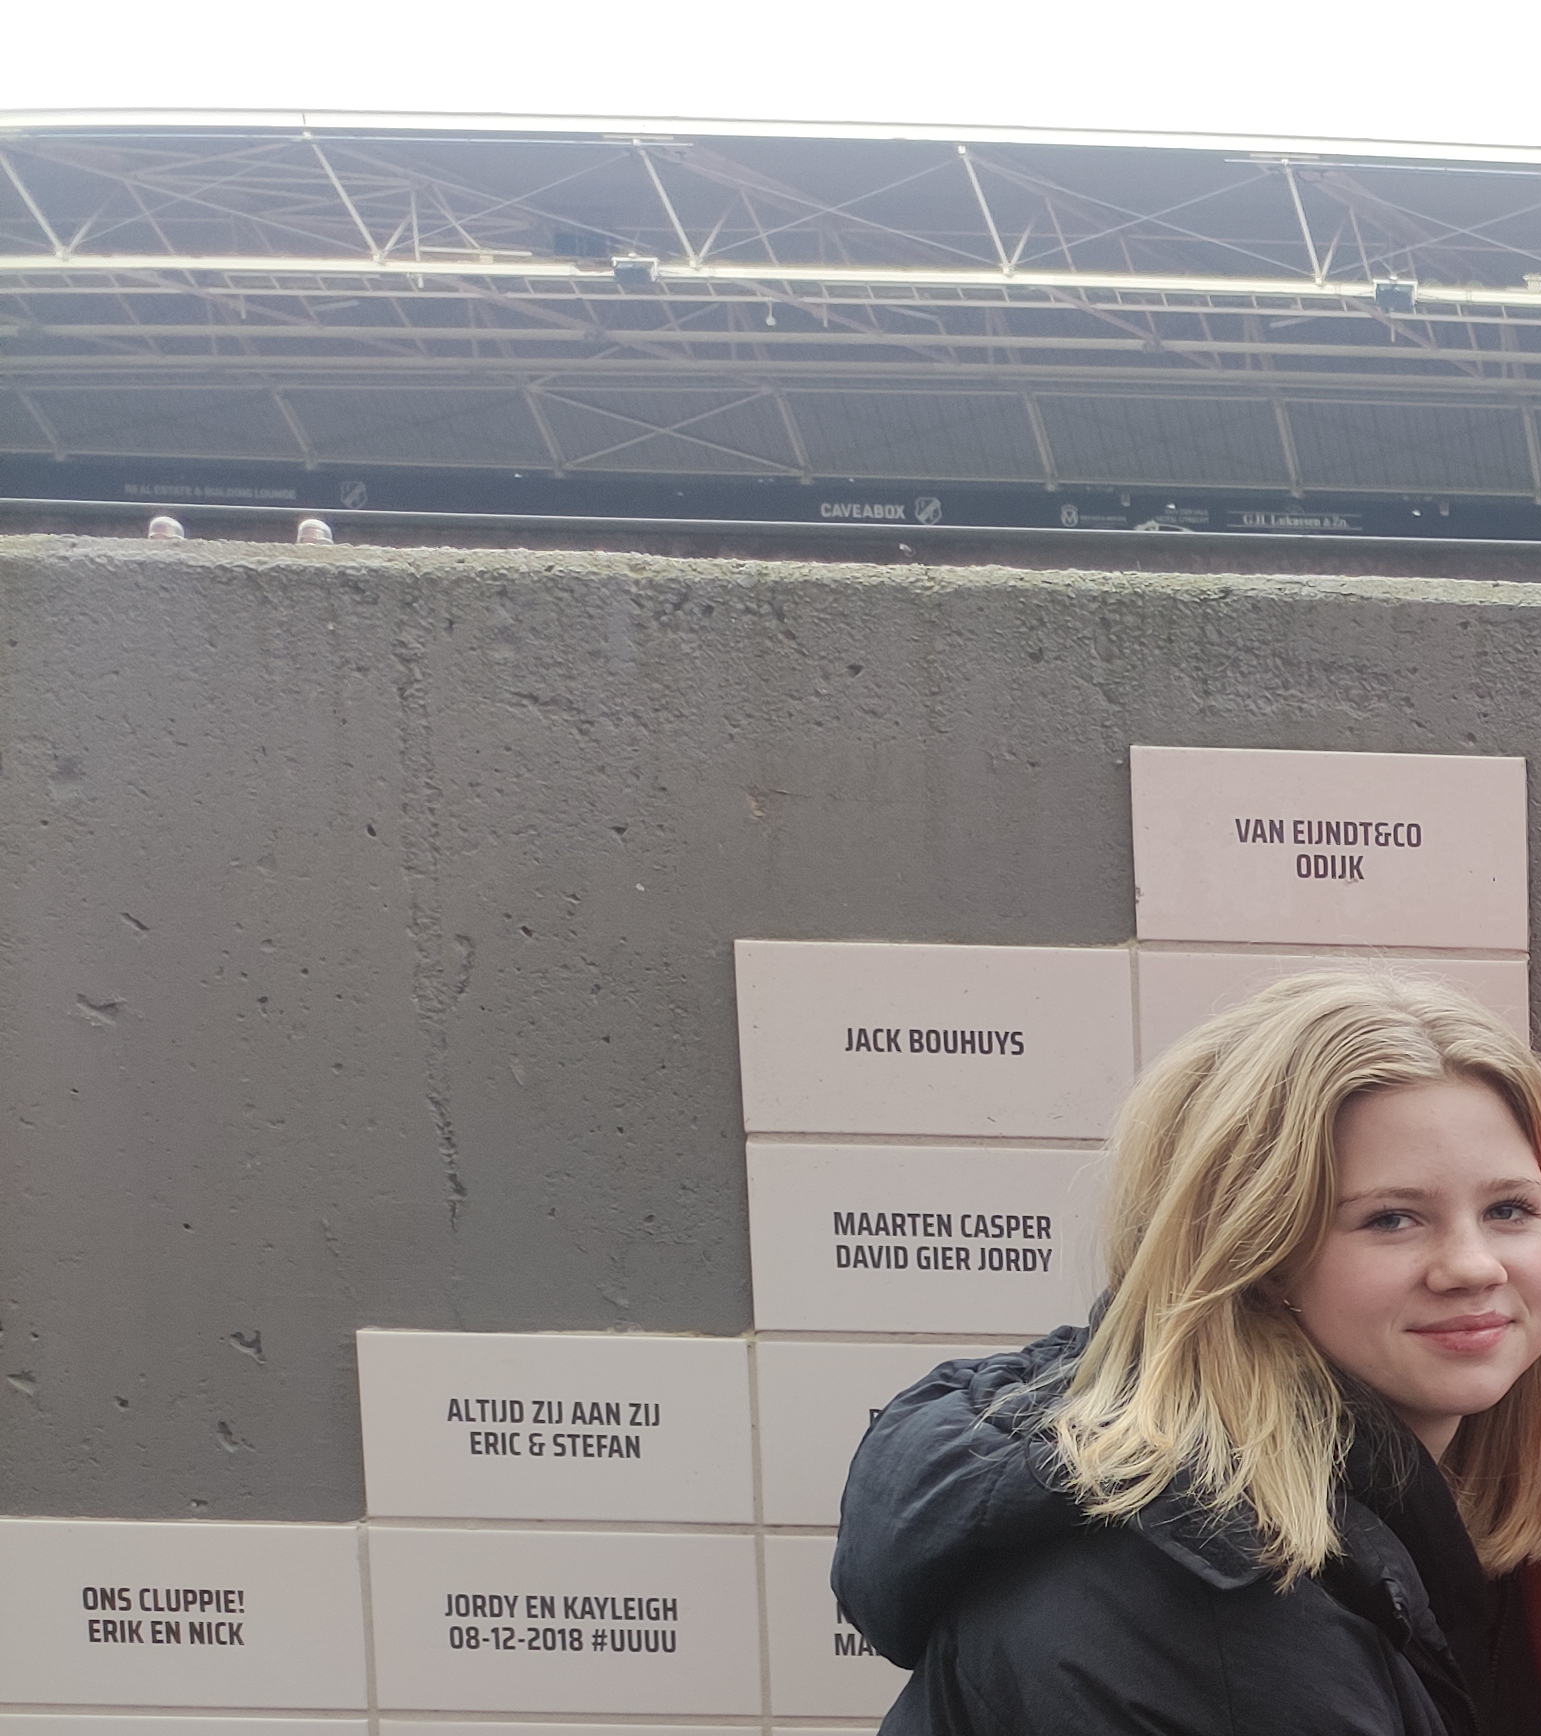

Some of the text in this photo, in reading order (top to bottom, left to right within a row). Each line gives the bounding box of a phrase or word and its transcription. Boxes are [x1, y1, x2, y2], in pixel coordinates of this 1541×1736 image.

[820, 502, 906, 519] CAVEABOX
[1234, 818, 1422, 848] VAN EIJNDT&CO
[1296, 853, 1365, 880] ODIJK
[845, 1027, 1025, 1056] JACK BOUHUYS
[833, 1211, 1052, 1240] MAARTEN CASPER
[836, 1244, 1053, 1273] DAVID GIER JORDY
[447, 1398, 660, 1427] ALTIJD ZIJ AAN ZIJ
[469, 1431, 641, 1459] ERIC & STEFAN
[82, 1586, 245, 1614] ONS CLUPPIE!
[444, 1593, 678, 1622] JORDY EN KAYLEIGH
[88, 1619, 245, 1646] ERIK EN NICK
[449, 1625, 677, 1653] 08-12-2018 #UUUU
